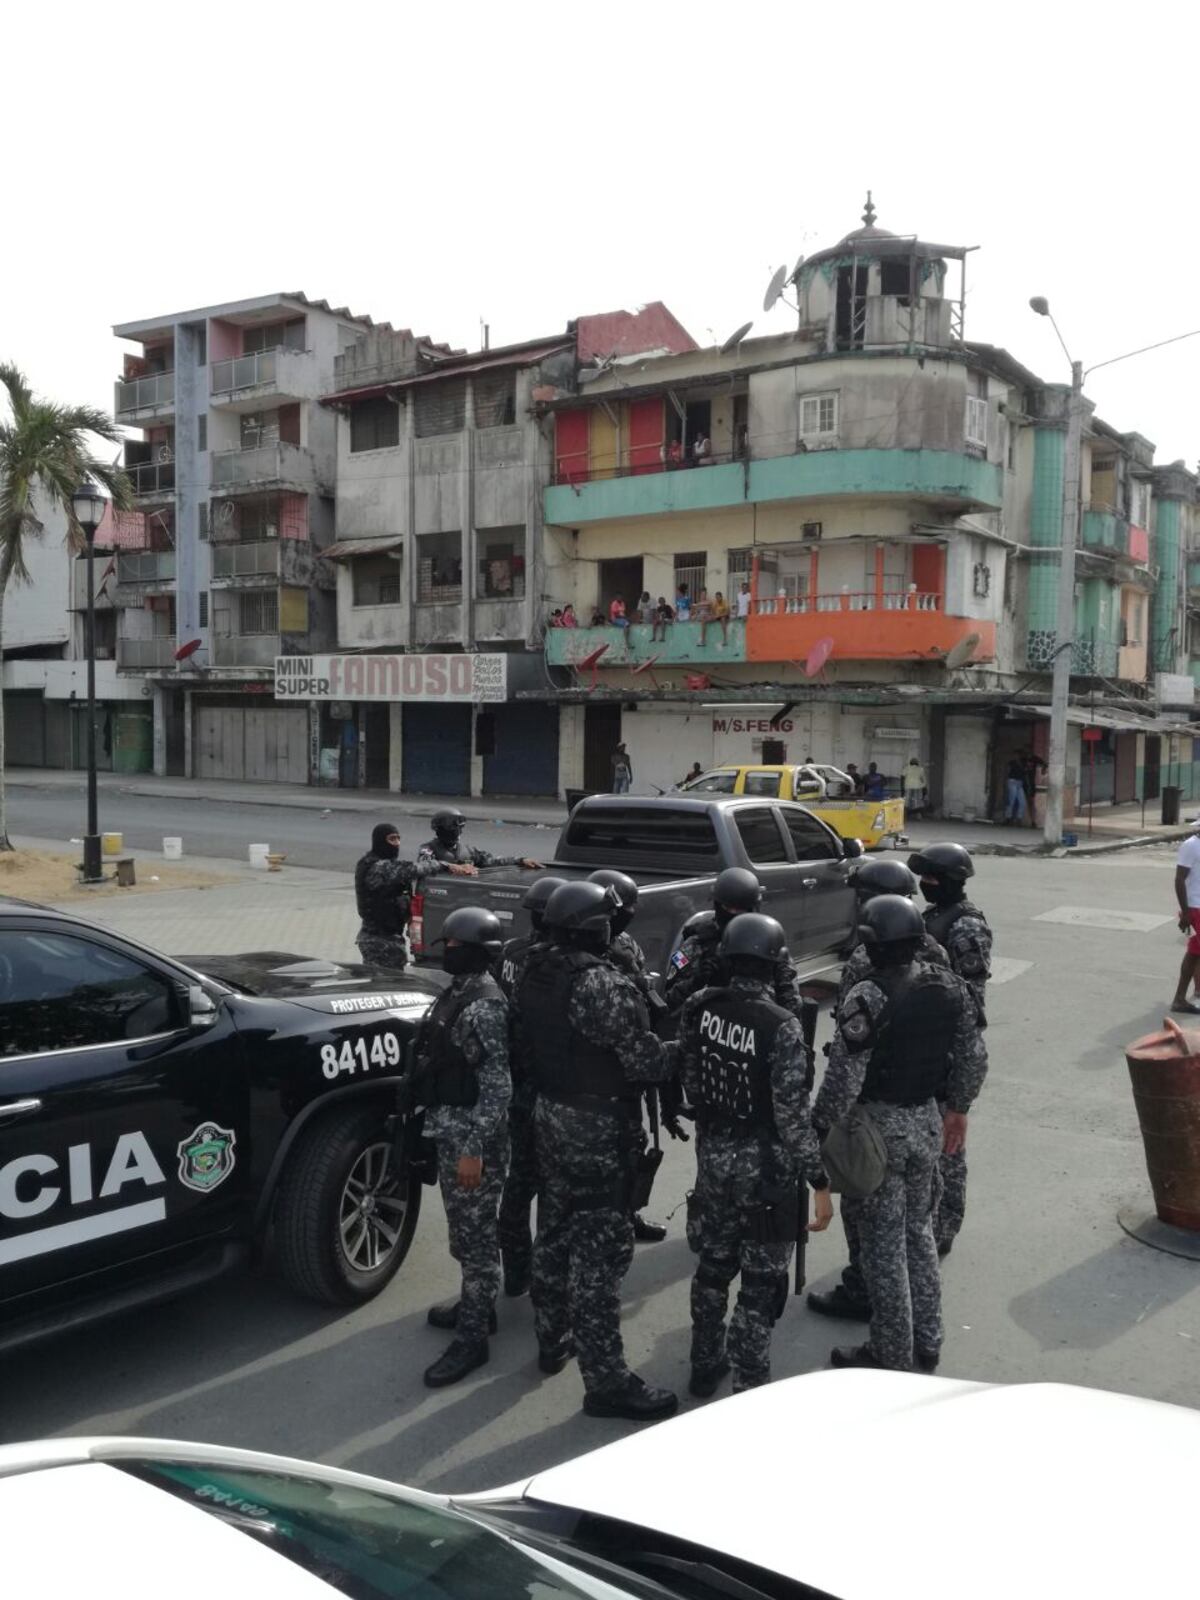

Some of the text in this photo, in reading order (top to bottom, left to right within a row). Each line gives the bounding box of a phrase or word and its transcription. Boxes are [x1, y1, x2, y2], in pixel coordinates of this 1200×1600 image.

[276, 658, 313, 676] MINI
[329, 655, 472, 696] FAMOSO
[276, 678, 329, 695] SUPER
[330, 996, 386, 1013] PROTEGER
[384, 995, 394, 1008] Y
[700, 1010, 756, 1056] POLICIA
[320, 1032, 400, 1079] 84149
